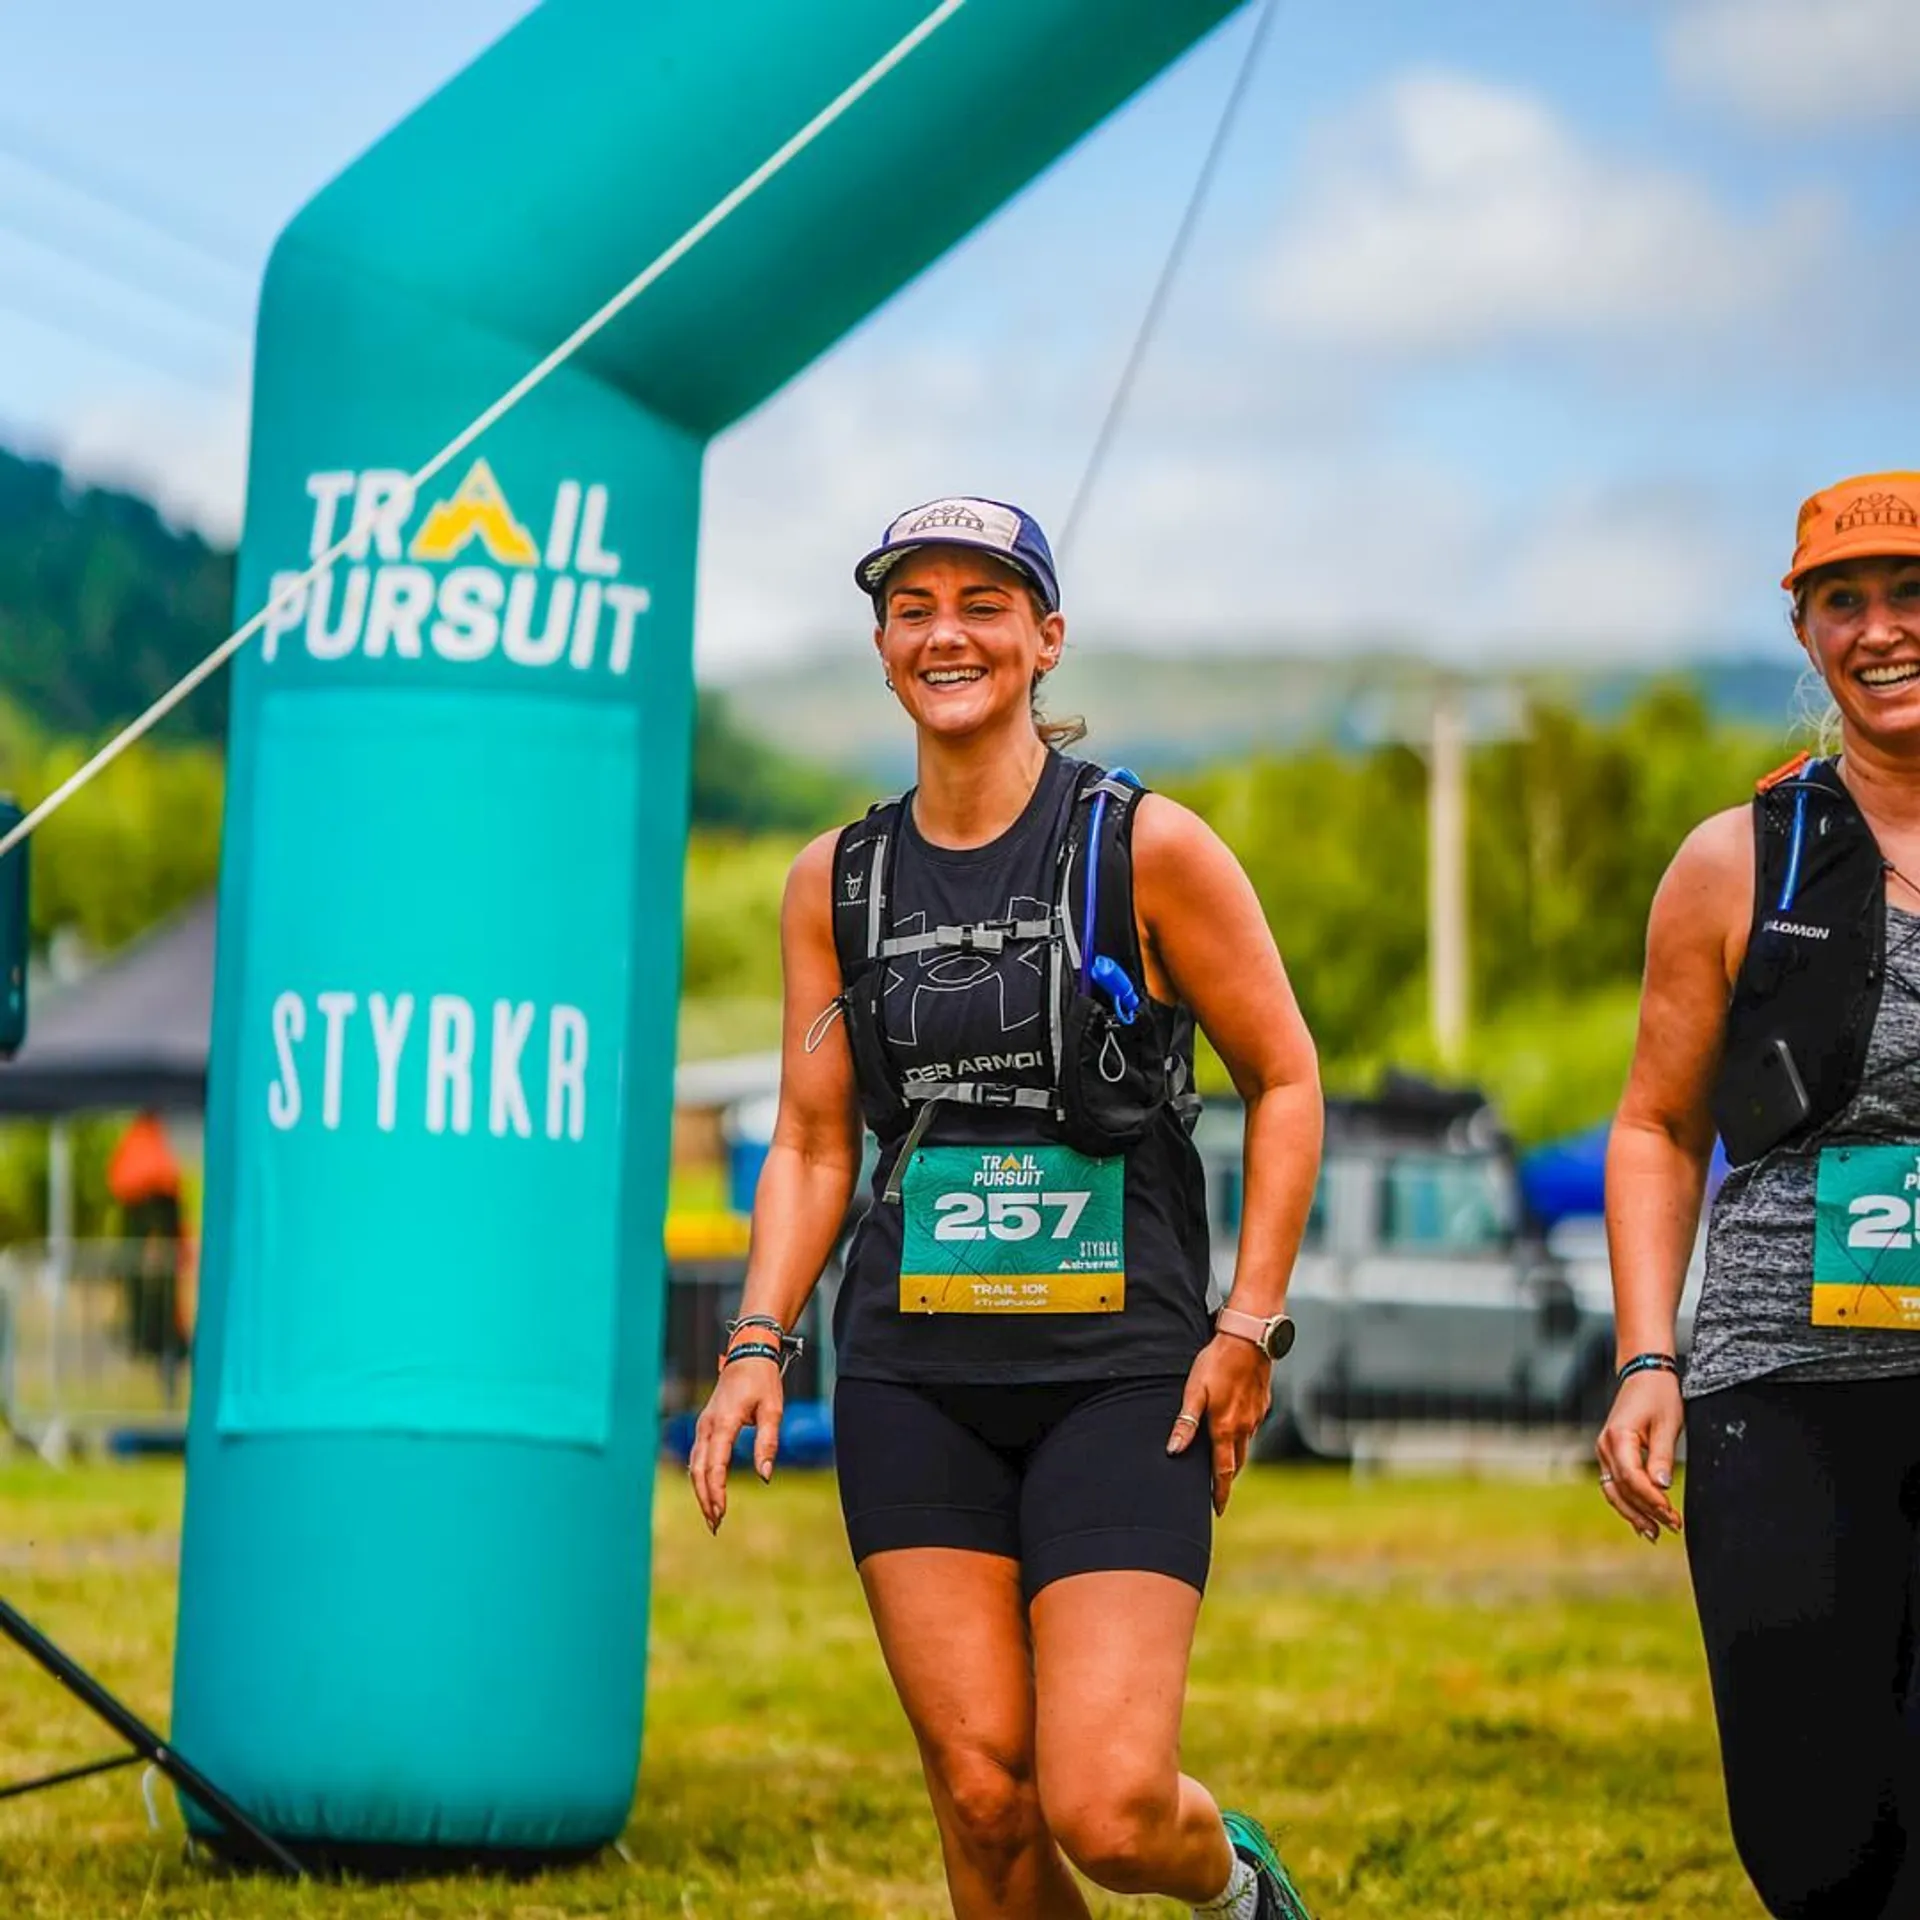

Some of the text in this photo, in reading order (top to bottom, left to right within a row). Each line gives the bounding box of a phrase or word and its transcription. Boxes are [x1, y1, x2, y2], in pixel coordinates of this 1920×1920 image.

[305, 457, 621, 578] TRAIL
[261, 563, 651, 675] PURSUIT
[267, 990, 589, 1142] STYRKR
[904, 1063, 953, 1083] DER
[973, 1170, 1044, 1187] PURSUIT
[981, 1153, 1037, 1171] TRAIL
[934, 1191, 1092, 1241] 257
[1847, 1194, 1920, 1249] 2
[969, 1283, 1049, 1295] TRAIL 10K
